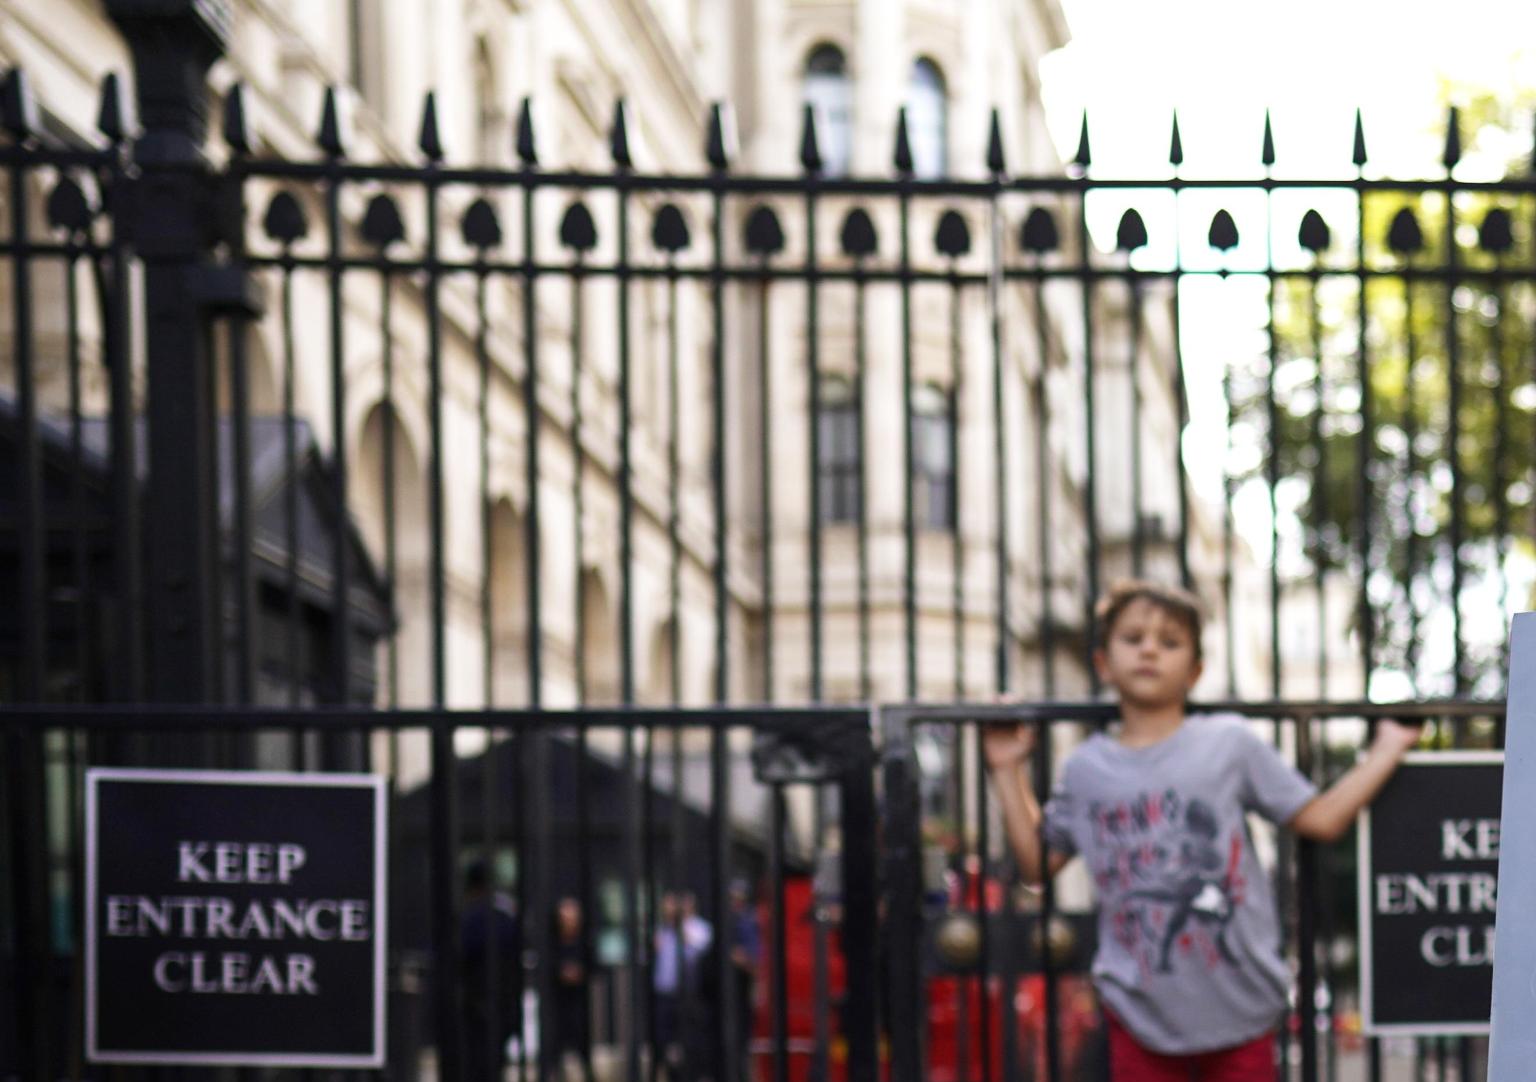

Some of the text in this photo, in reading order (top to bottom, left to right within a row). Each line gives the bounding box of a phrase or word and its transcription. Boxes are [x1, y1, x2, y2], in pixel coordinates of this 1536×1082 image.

[178, 841, 307, 885] KEEP
[107, 896, 370, 941] ENTRANCE
[154, 952, 317, 995] CLEAR
